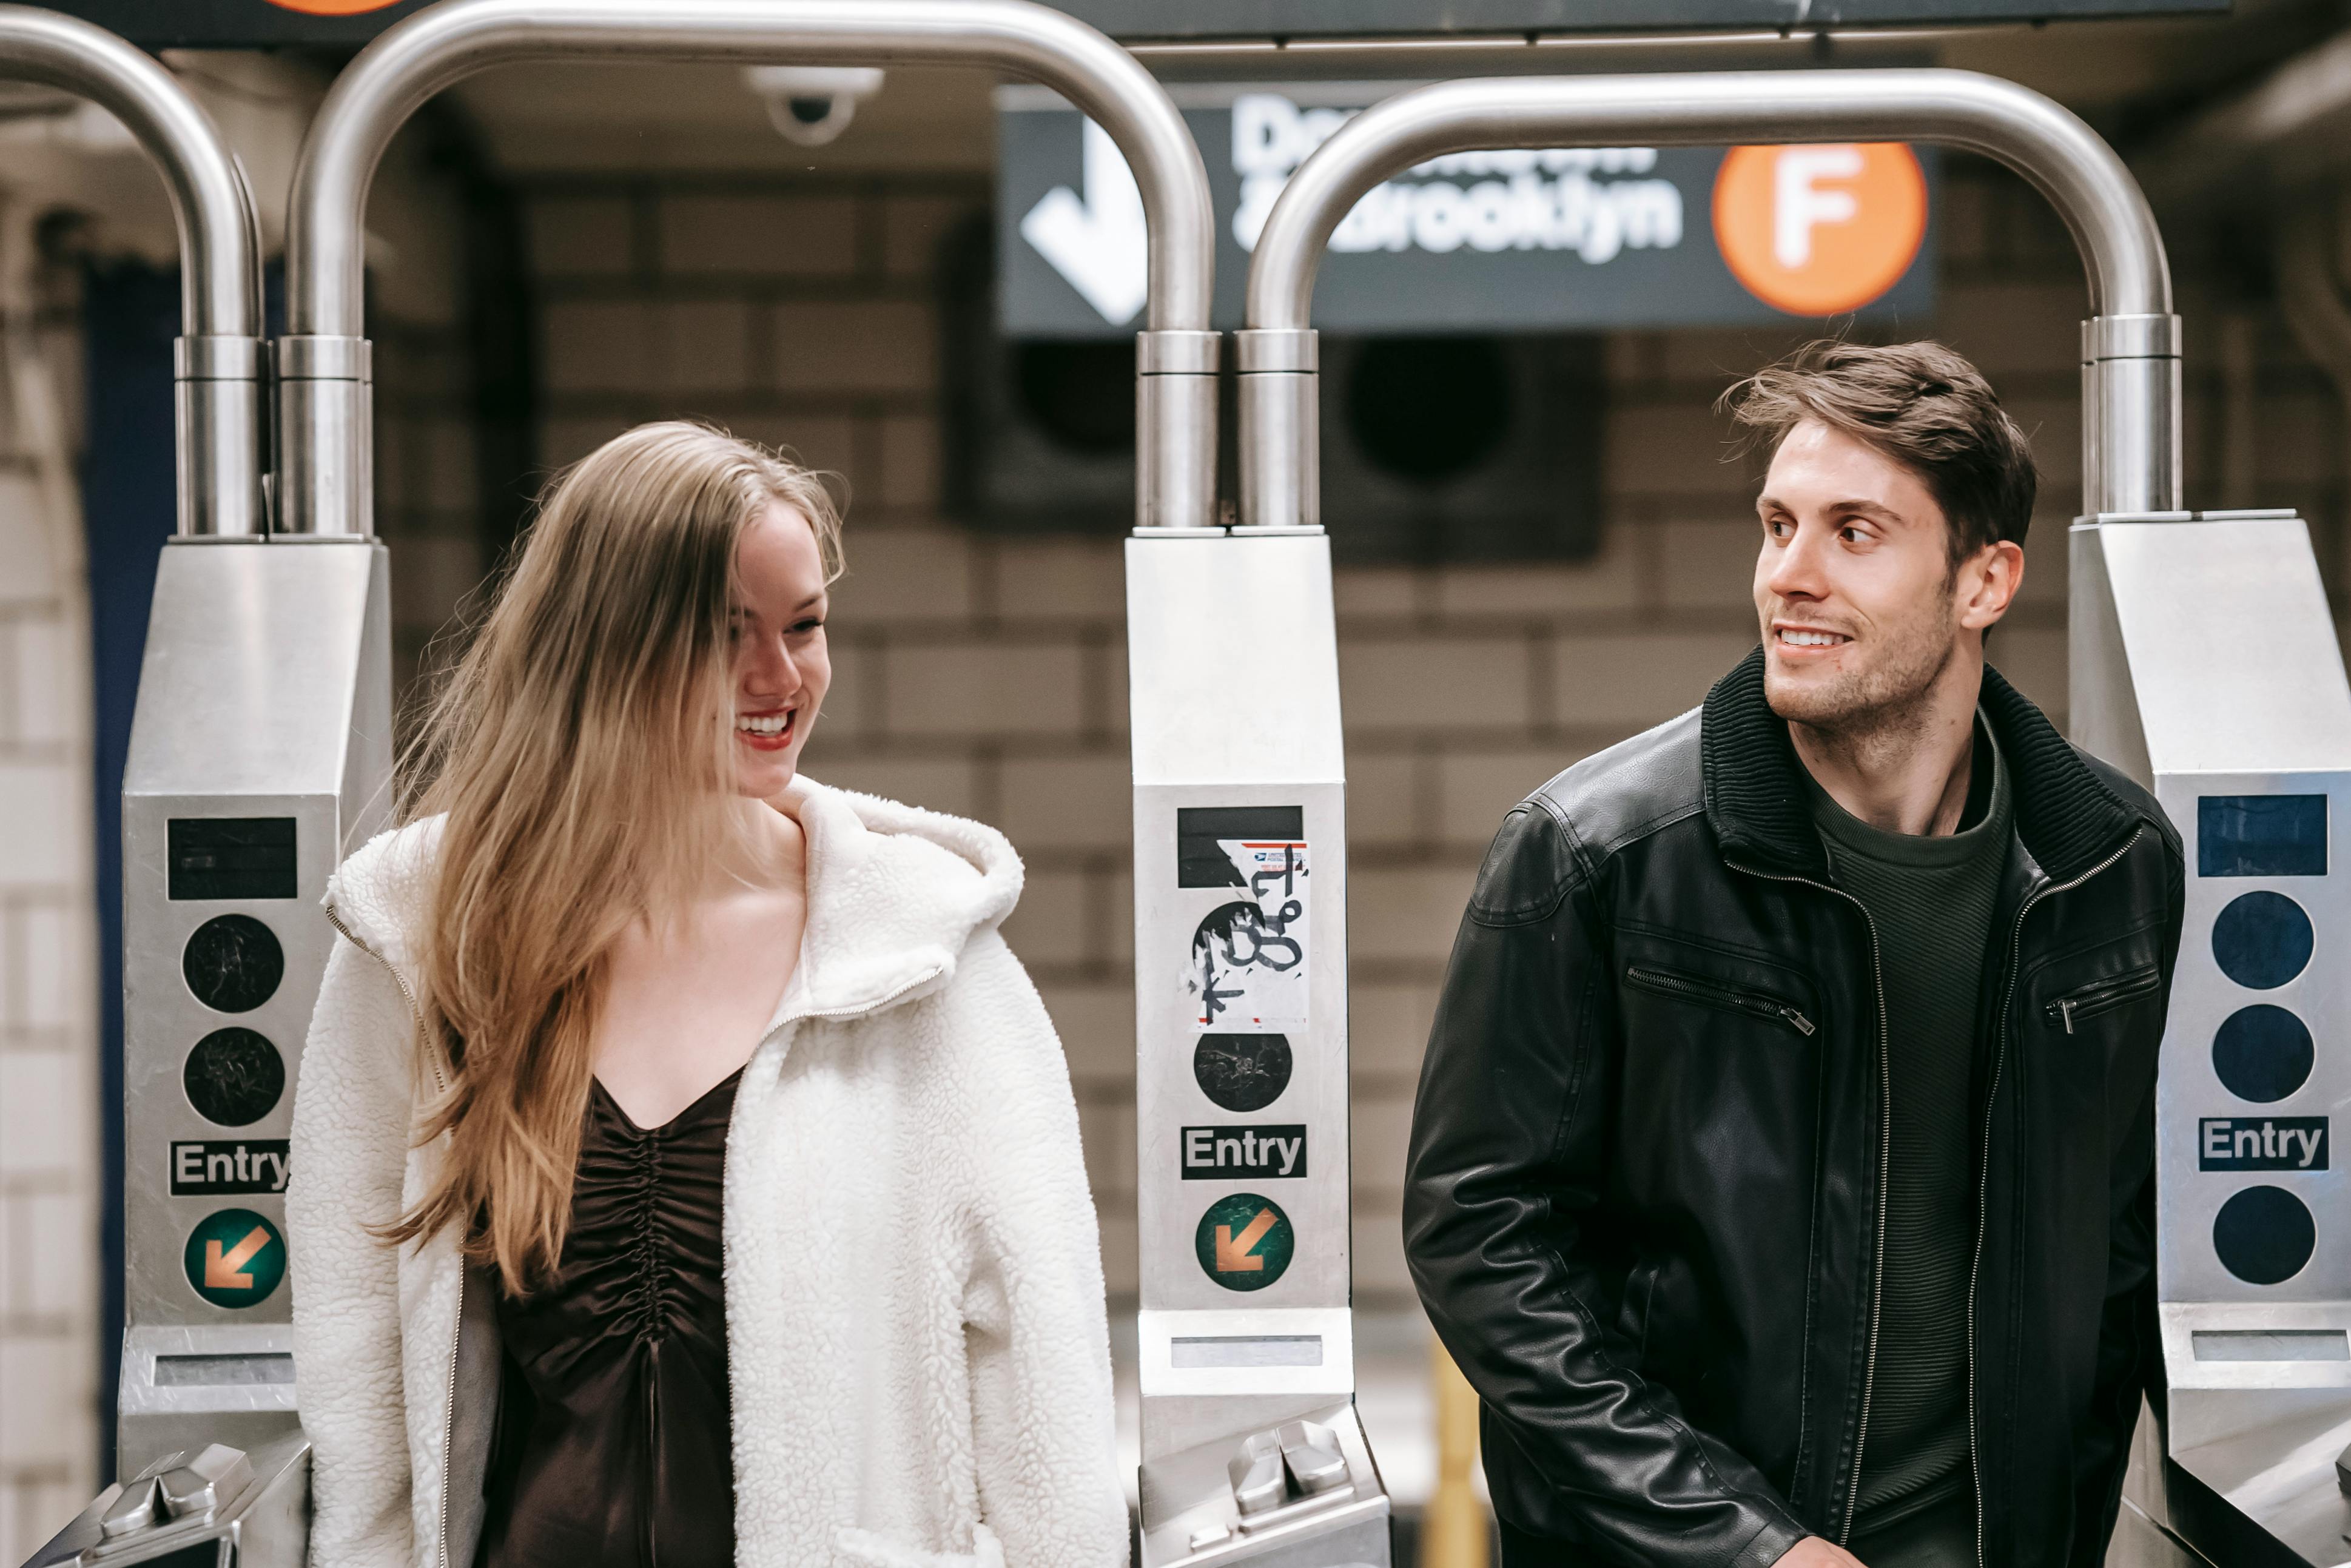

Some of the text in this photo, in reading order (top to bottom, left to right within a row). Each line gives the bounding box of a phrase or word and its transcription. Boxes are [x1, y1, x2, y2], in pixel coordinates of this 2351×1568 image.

[1774, 144, 1864, 268] F
[177, 1145, 291, 1190] Entry
[1186, 1130, 1302, 1176] Entry
[2204, 1121, 2323, 1168] Entry
